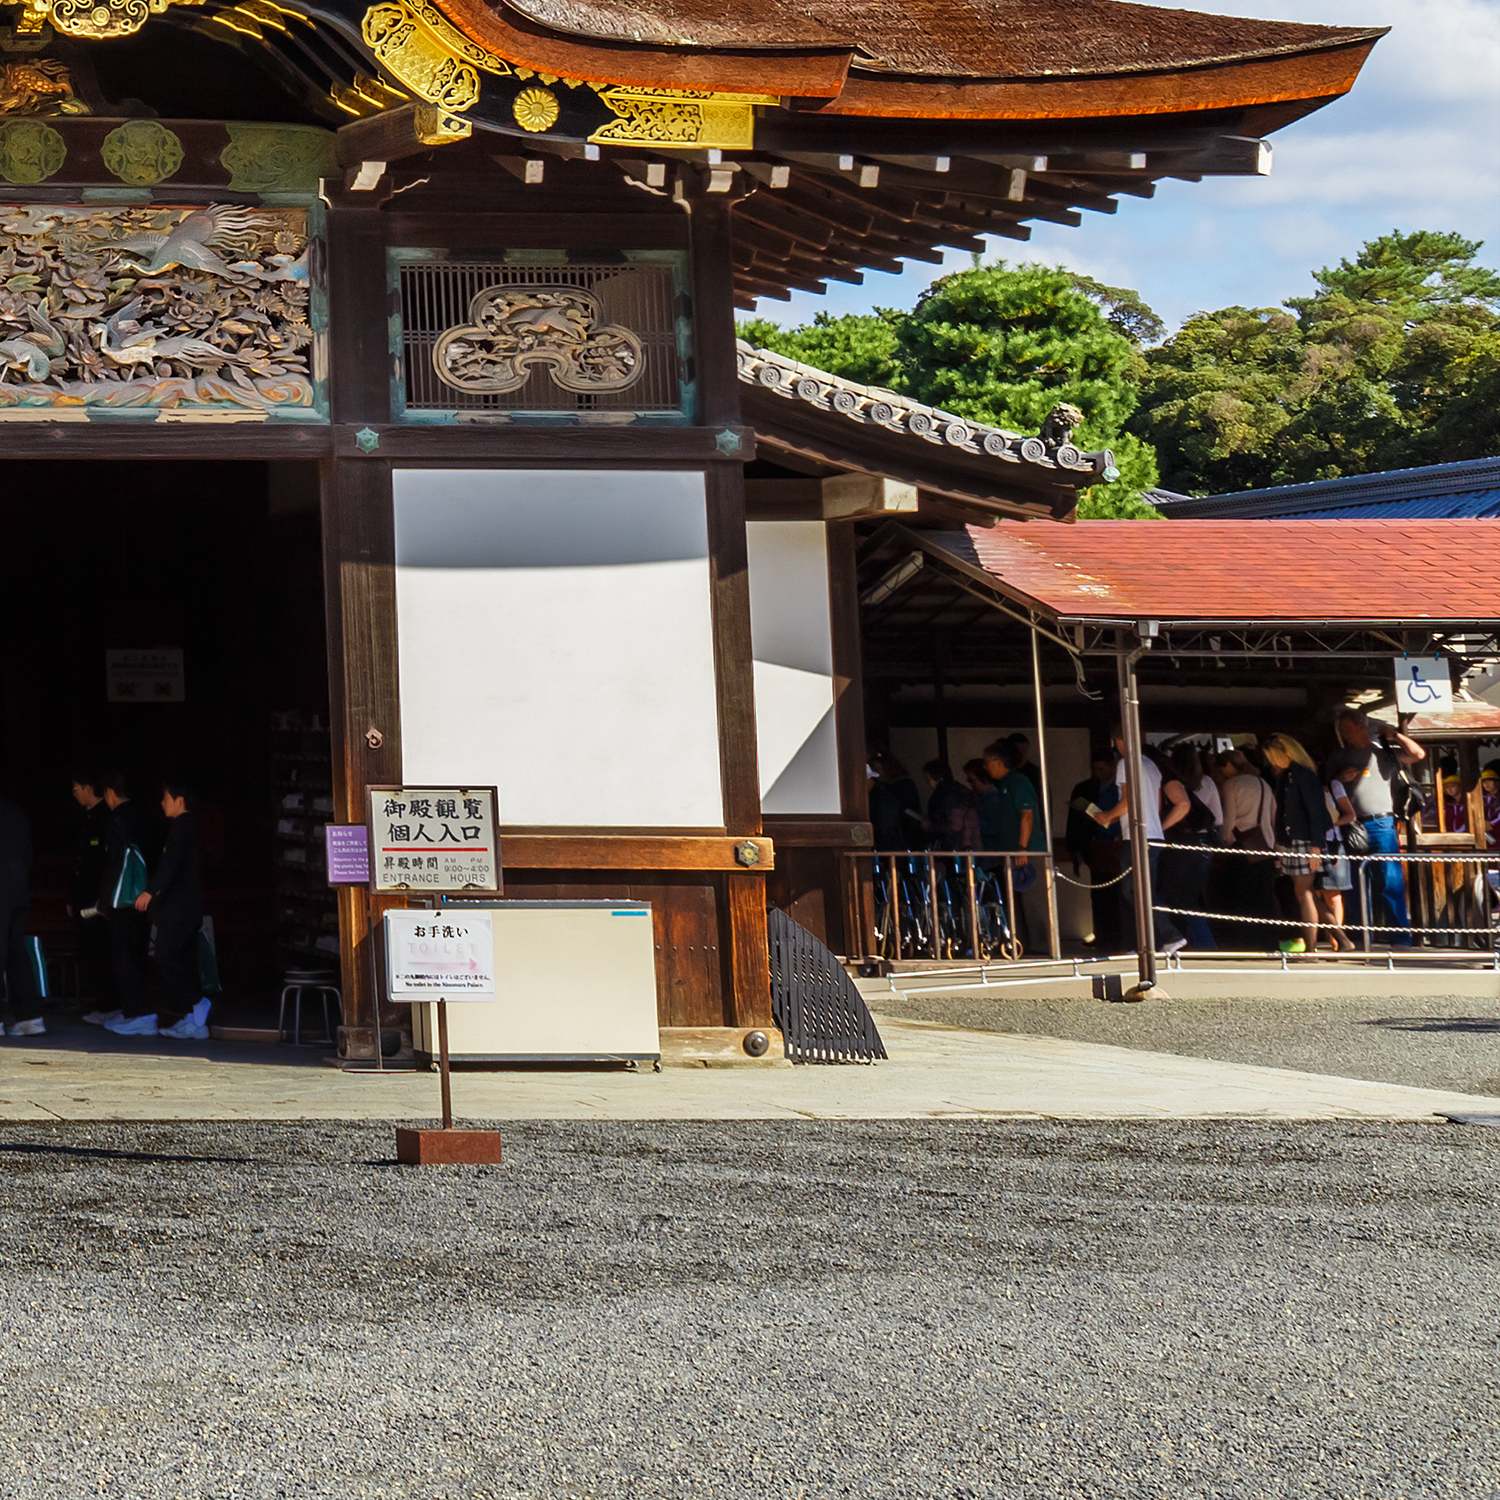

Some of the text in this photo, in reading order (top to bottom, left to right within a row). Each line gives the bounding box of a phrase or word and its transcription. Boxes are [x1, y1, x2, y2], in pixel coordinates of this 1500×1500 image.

[383, 798, 483, 819] 御殿観覧
[387, 823, 481, 842] 個人入口
[383, 856, 438, 870] 昇殿時間
[383, 873, 486, 883] ENTRANCE HOURS
[413, 925, 469, 938] お手洗い
[407, 942, 477, 954] TOILET
